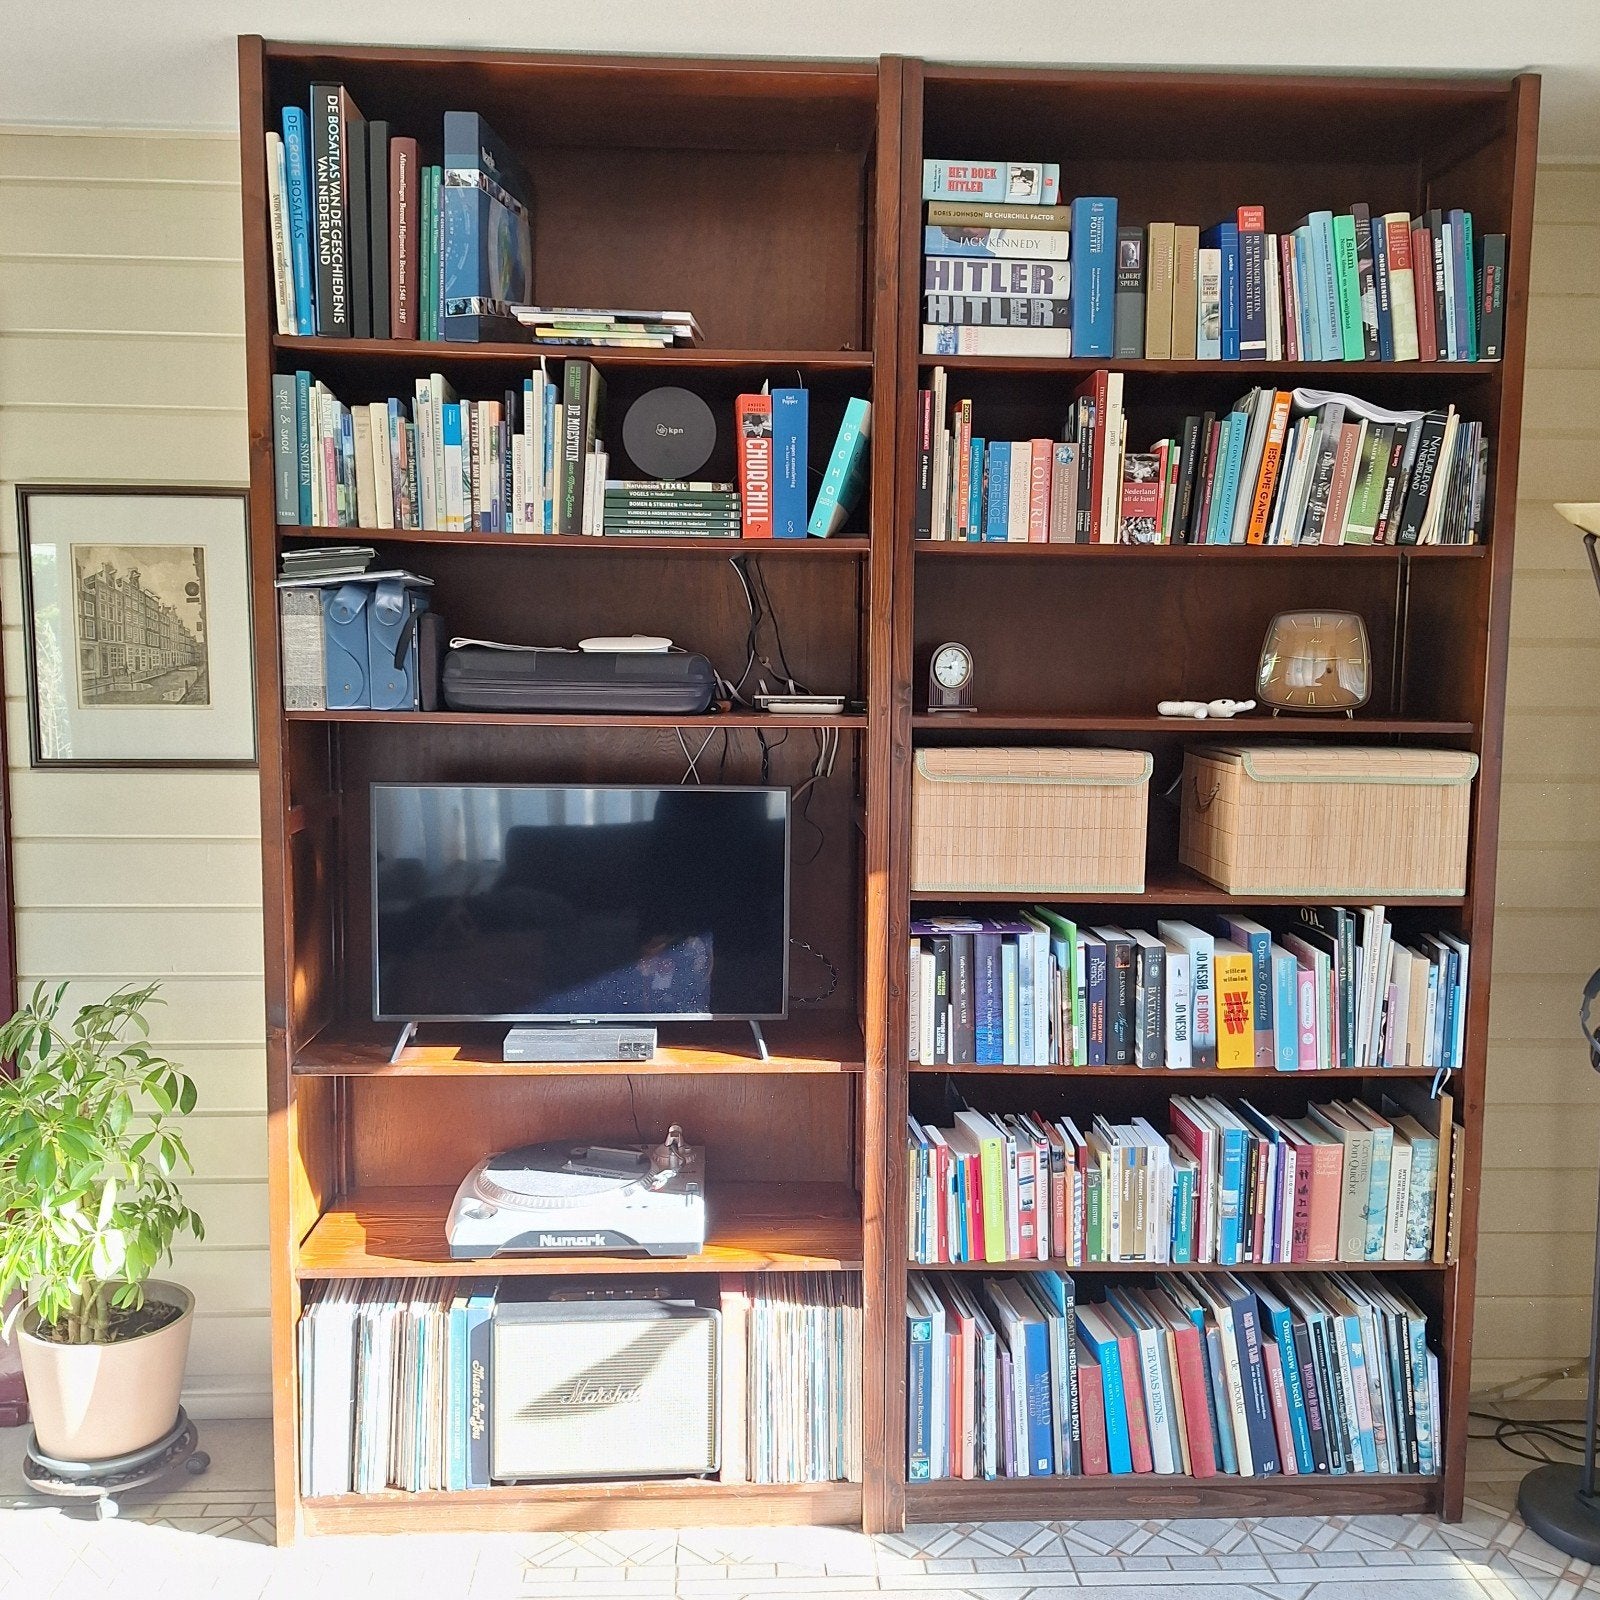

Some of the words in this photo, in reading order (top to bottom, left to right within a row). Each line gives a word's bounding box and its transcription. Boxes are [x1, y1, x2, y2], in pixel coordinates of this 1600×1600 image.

[327, 95, 339, 112] DE
[287, 115, 298, 133] DE
[289, 136, 302, 181] GROTE
[327, 115, 340, 181] BOSATLAS
[317, 156, 328, 180] VAN
[948, 167, 967, 178] HET
[971, 168, 997, 179] BOEK
[331, 181, 342, 208] VAN
[948, 181, 983, 192] HITLER
[292, 180, 304, 239] BOSATLAS
[331, 211, 342, 228] DE
[318, 183, 330, 265] NEDERLAND
[959, 237, 986, 247] JACK
[988, 239, 1041, 249] KENNEDY
[1246, 236, 1251, 244] IN
[1246, 247, 1252, 255] DE
[1254, 236, 1260, 244] DE
[1435, 238, 1443, 264] Jihadi's
[1346, 238, 1354, 269] Islam
[330, 232, 344, 324] GESCHIEDENIS
[926, 260, 1054, 294] HITLER
[927, 295, 1054, 326] HITLER
[276, 389, 291, 411] spit
[568, 405, 580, 417] DE
[280, 415, 290, 424] &
[669, 426, 683, 434] kpn
[1234, 419, 1242, 441] PLATO
[1269, 403, 1288, 444] LUPIN
[1375, 428, 1380, 436] DE
[281, 428, 292, 454] snoei
[566, 418, 580, 462] MOESTUIN
[1370, 438, 1379, 460] WAAIER
[1423, 440, 1429, 448] IN
[301, 443, 309, 486] SNOEIEN
[1187, 450, 1195, 474] HAWKING
[1226, 444, 1239, 492] CONSTITUTIE
[1262, 448, 1278, 489] ESCAPE
[1340, 432, 1354, 479] AGINCOURT
[1419, 436, 1441, 497] NATUURLEVEN
[746, 439, 769, 525] CHURCHILL
[1413, 449, 1428, 490] NEDERLAND
[474, 479, 479, 487] EN
[660, 482, 689, 490] TEXEL
[990, 460, 1001, 524] FLORENCE
[1031, 456, 1045, 528] LOUVRE
[1124, 488, 1156, 496] Nederland
[1255, 492, 1267, 524] GAME
[1312, 502, 1322, 522] 1812
[1361, 487, 1370, 513] FORTUIN
[1379, 478, 1395, 520] Warmoesstraat
[1376, 521, 1386, 540] Bureau
[1197, 952, 1208, 963] JO
[1258, 941, 1268, 969] Opera
[1090, 958, 1098, 986] French
[1197, 964, 1208, 990] NESBØ
[1259, 972, 1267, 981] &
[1146, 986, 1156, 1038] BATAVIA
[1176, 1002, 1186, 1014] JO
[1197, 995, 1208, 1006] DE
[1259, 983, 1267, 1021] Operette
[1175, 1015, 1186, 1041] NESBØ
[1198, 1008, 1209, 1034] DORST
[1361, 1139, 1371, 1182] Cervantes
[1348, 1160, 1358, 1195] Quichot
[540, 1233, 605, 1247] Numark
[1067, 1296, 1073, 1307] DE
[1282, 1321, 1291, 1345] Onze
[1146, 1346, 1156, 1362] ER
[1230, 1359, 1239, 1370] de
[1286, 1346, 1295, 1369] eeuw
[472, 1360, 485, 1397] Music
[1069, 1348, 1078, 1396] NEDERLAND
[1150, 1364, 1159, 1390] WAS
[1290, 1372, 1297, 1381] in
[1041, 1372, 1051, 1425] WERELD
[1292, 1382, 1302, 1408] beeld
[1153, 1391, 1164, 1430] EENS...
